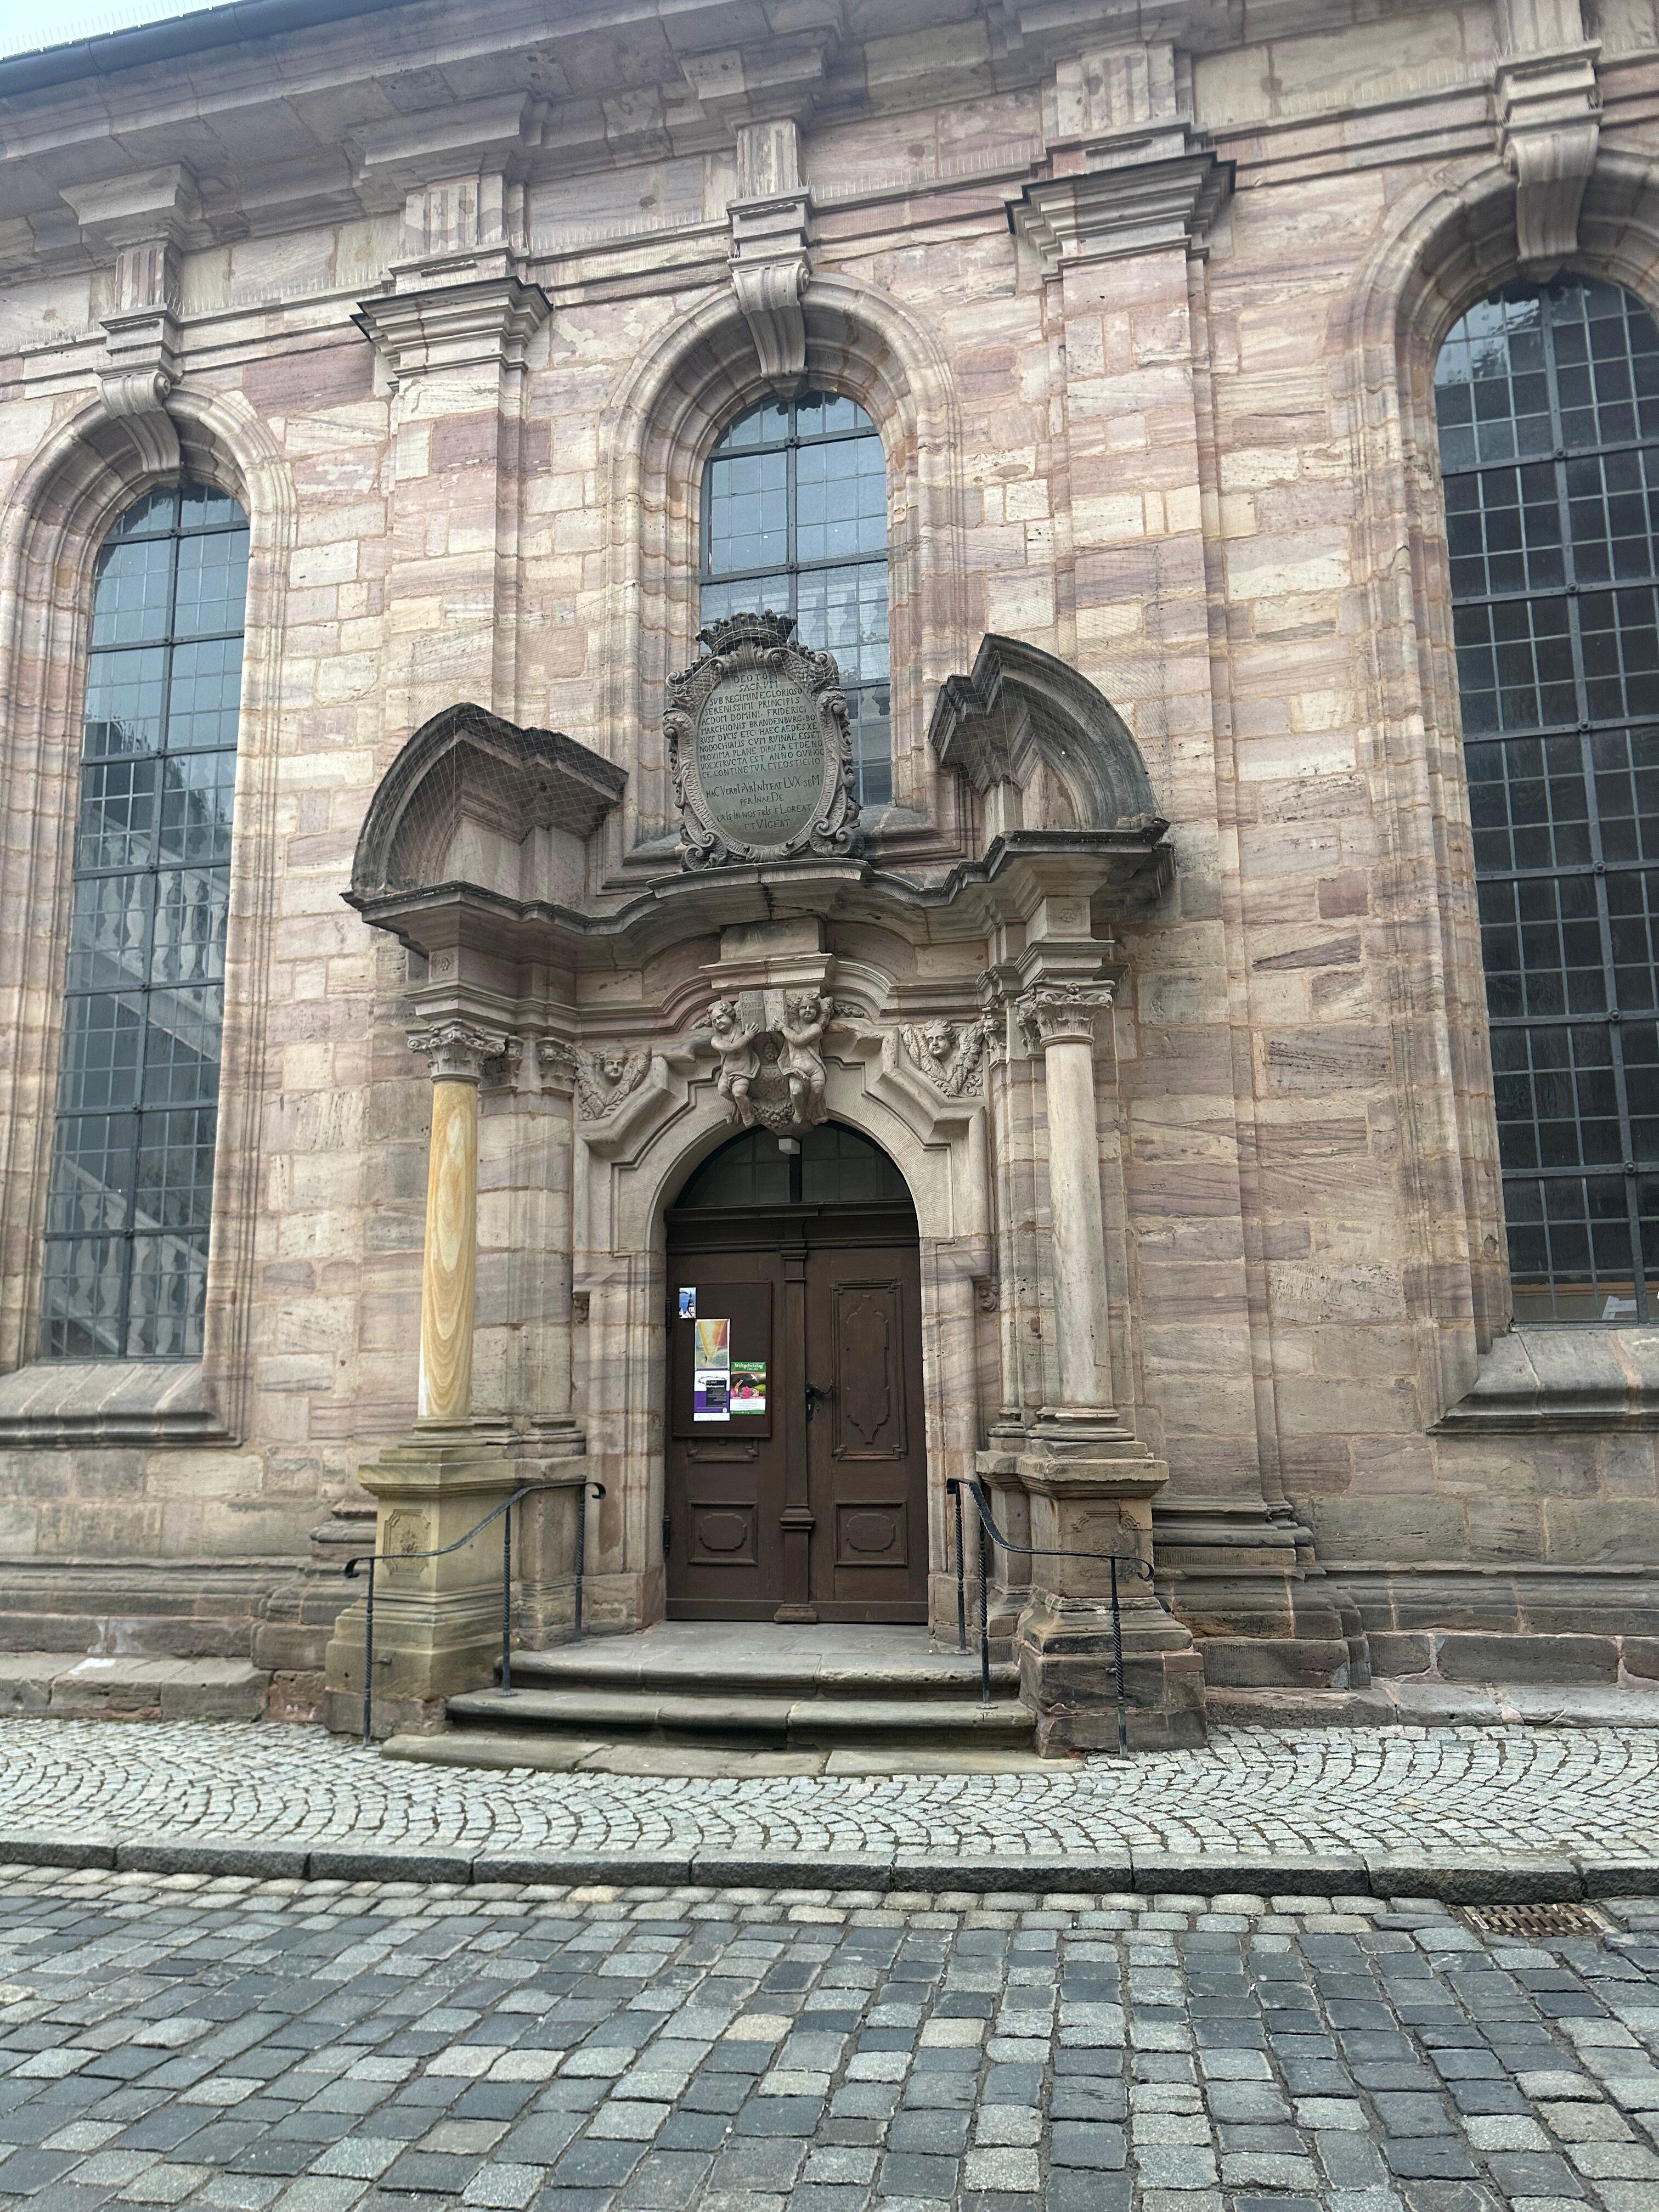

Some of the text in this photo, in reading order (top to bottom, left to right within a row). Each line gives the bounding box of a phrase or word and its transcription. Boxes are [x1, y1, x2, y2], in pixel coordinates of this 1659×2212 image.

[734, 674, 753, 684] DEO
[739, 680, 777, 692] SACRVM
[704, 697, 800, 716] SERENISSIMI PRINCIPIS
[709, 697, 723, 706] SVB
[767, 706, 806, 716] FRIDERICI
[700, 736, 715, 744] RVSS
[718, 732, 737, 741] DVCIS
[759, 726, 779, 735] HAEC
[702, 722, 746, 735] MARCHIONIS
[699, 731, 821, 753] NODOCHIALIS CVM RVINAE ESSET
[700, 751, 730, 761] PROXIMA
[733, 747, 757, 757] PLANE
[760, 743, 786, 753] DIRVTA
[750, 754, 764, 763] EST
[770, 752, 793, 761] ANNO
[714, 764, 766, 777] CONTINETVR
[783, 775, 802, 789] LVX
